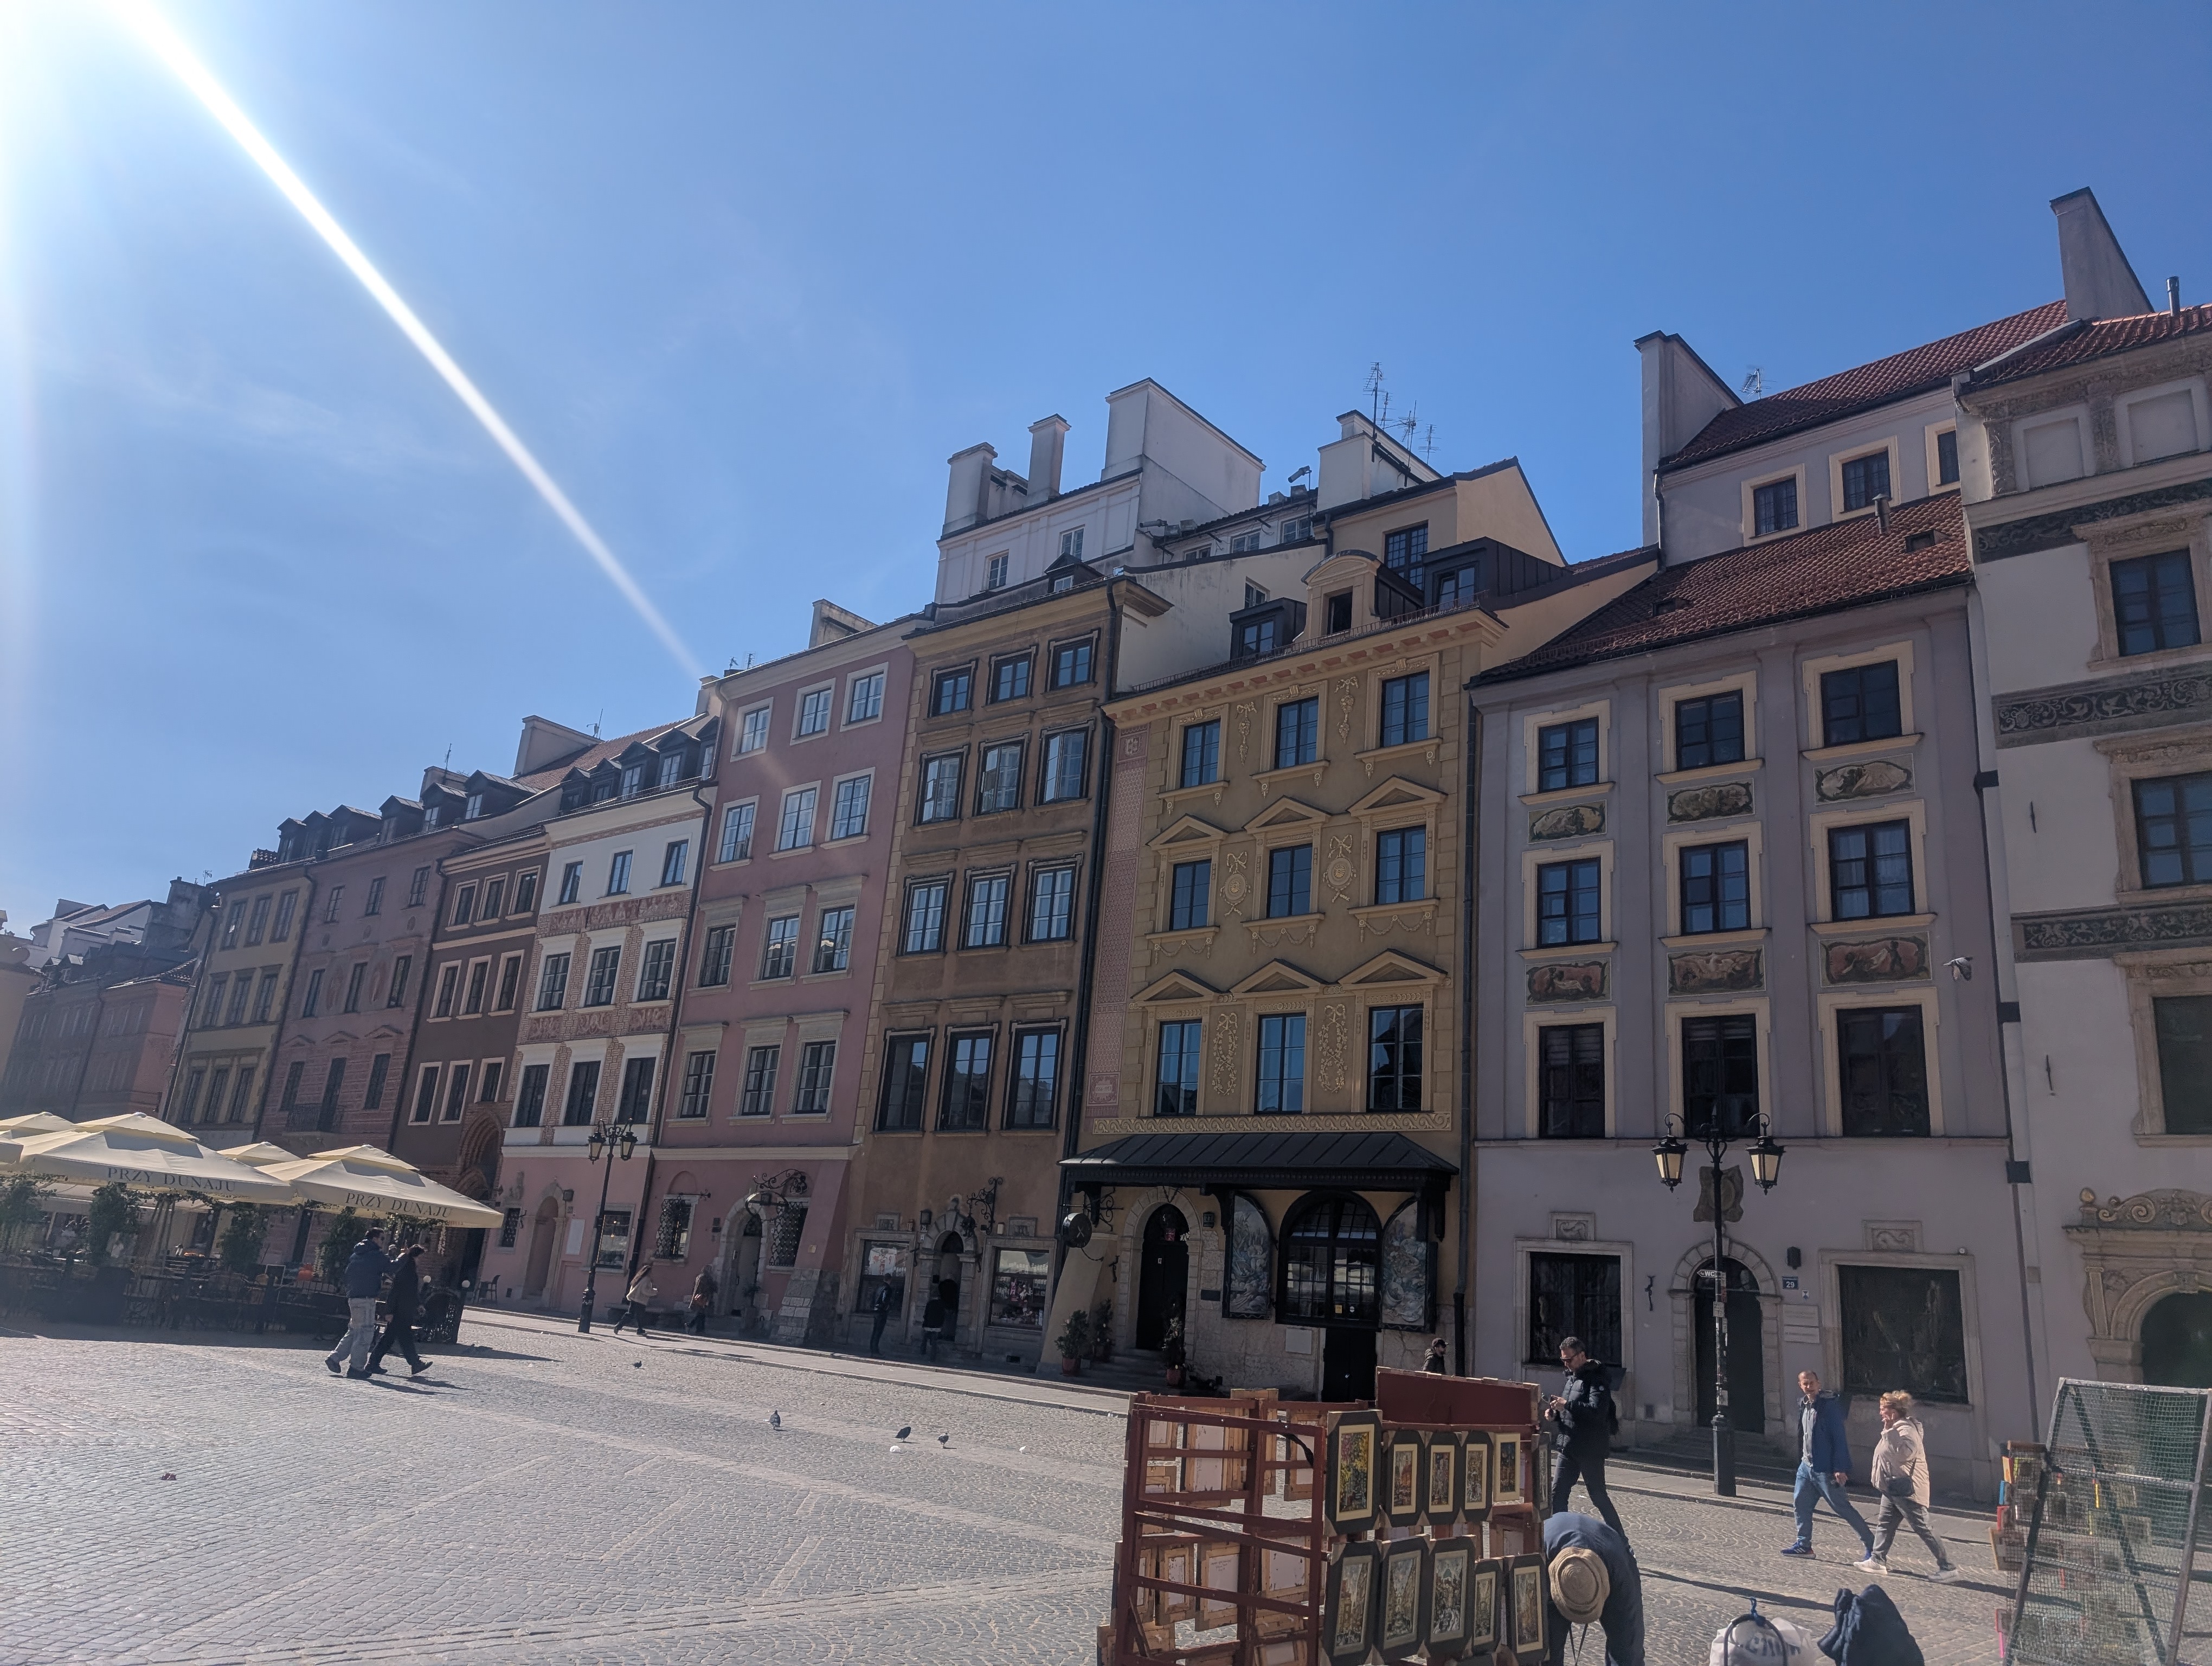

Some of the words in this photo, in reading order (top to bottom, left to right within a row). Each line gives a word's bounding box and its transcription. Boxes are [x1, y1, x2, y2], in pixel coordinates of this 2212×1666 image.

[108, 1167, 153, 1183] PRZY
[164, 1174, 235, 1192] DUNAJU
[345, 1193, 385, 1208] PRZY
[391, 1199, 452, 1218] DUNAJU
